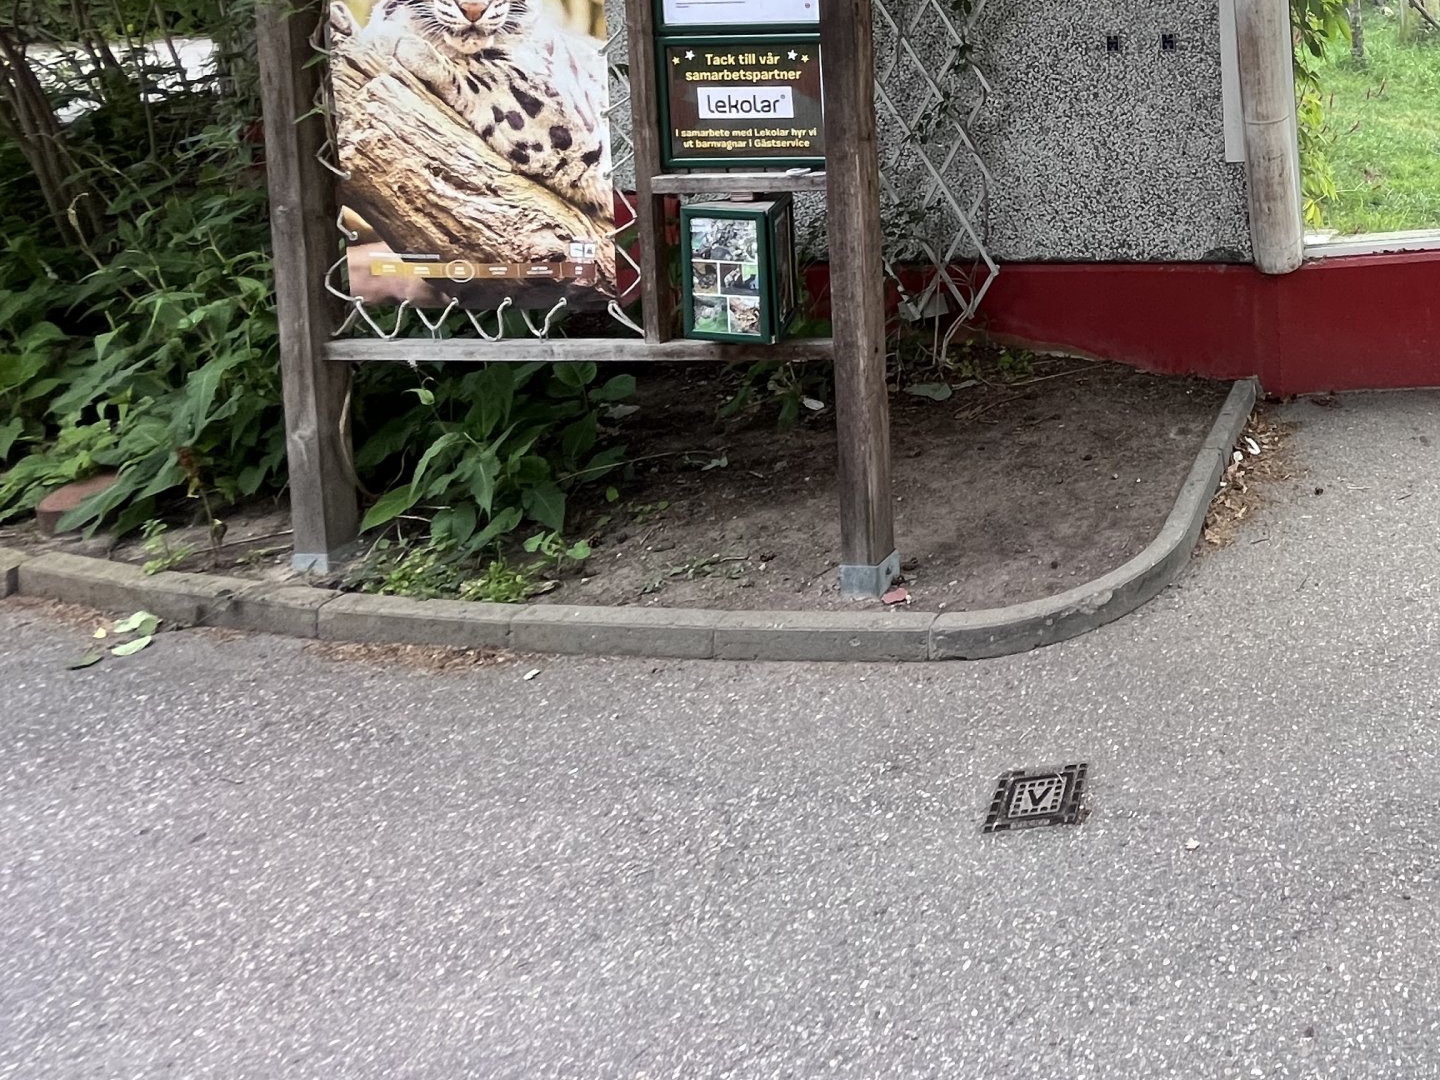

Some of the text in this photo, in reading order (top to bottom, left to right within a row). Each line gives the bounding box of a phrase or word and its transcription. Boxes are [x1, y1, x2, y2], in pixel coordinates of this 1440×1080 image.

[705, 52, 780, 66] Tack till vår
[685, 69, 802, 82] samarbetspartner
[681, 128, 730, 138] samarbete
[731, 128, 753, 137] med
[754, 127, 789, 137] Lekolar
[791, 127, 807, 138] hyr
[808, 127, 817, 136] vi
[683, 139, 694, 148] ut
[695, 139, 747, 151] barnvagnar
[753, 138, 810, 148] Gästservice
[1027, 786, 1054, 807] V
